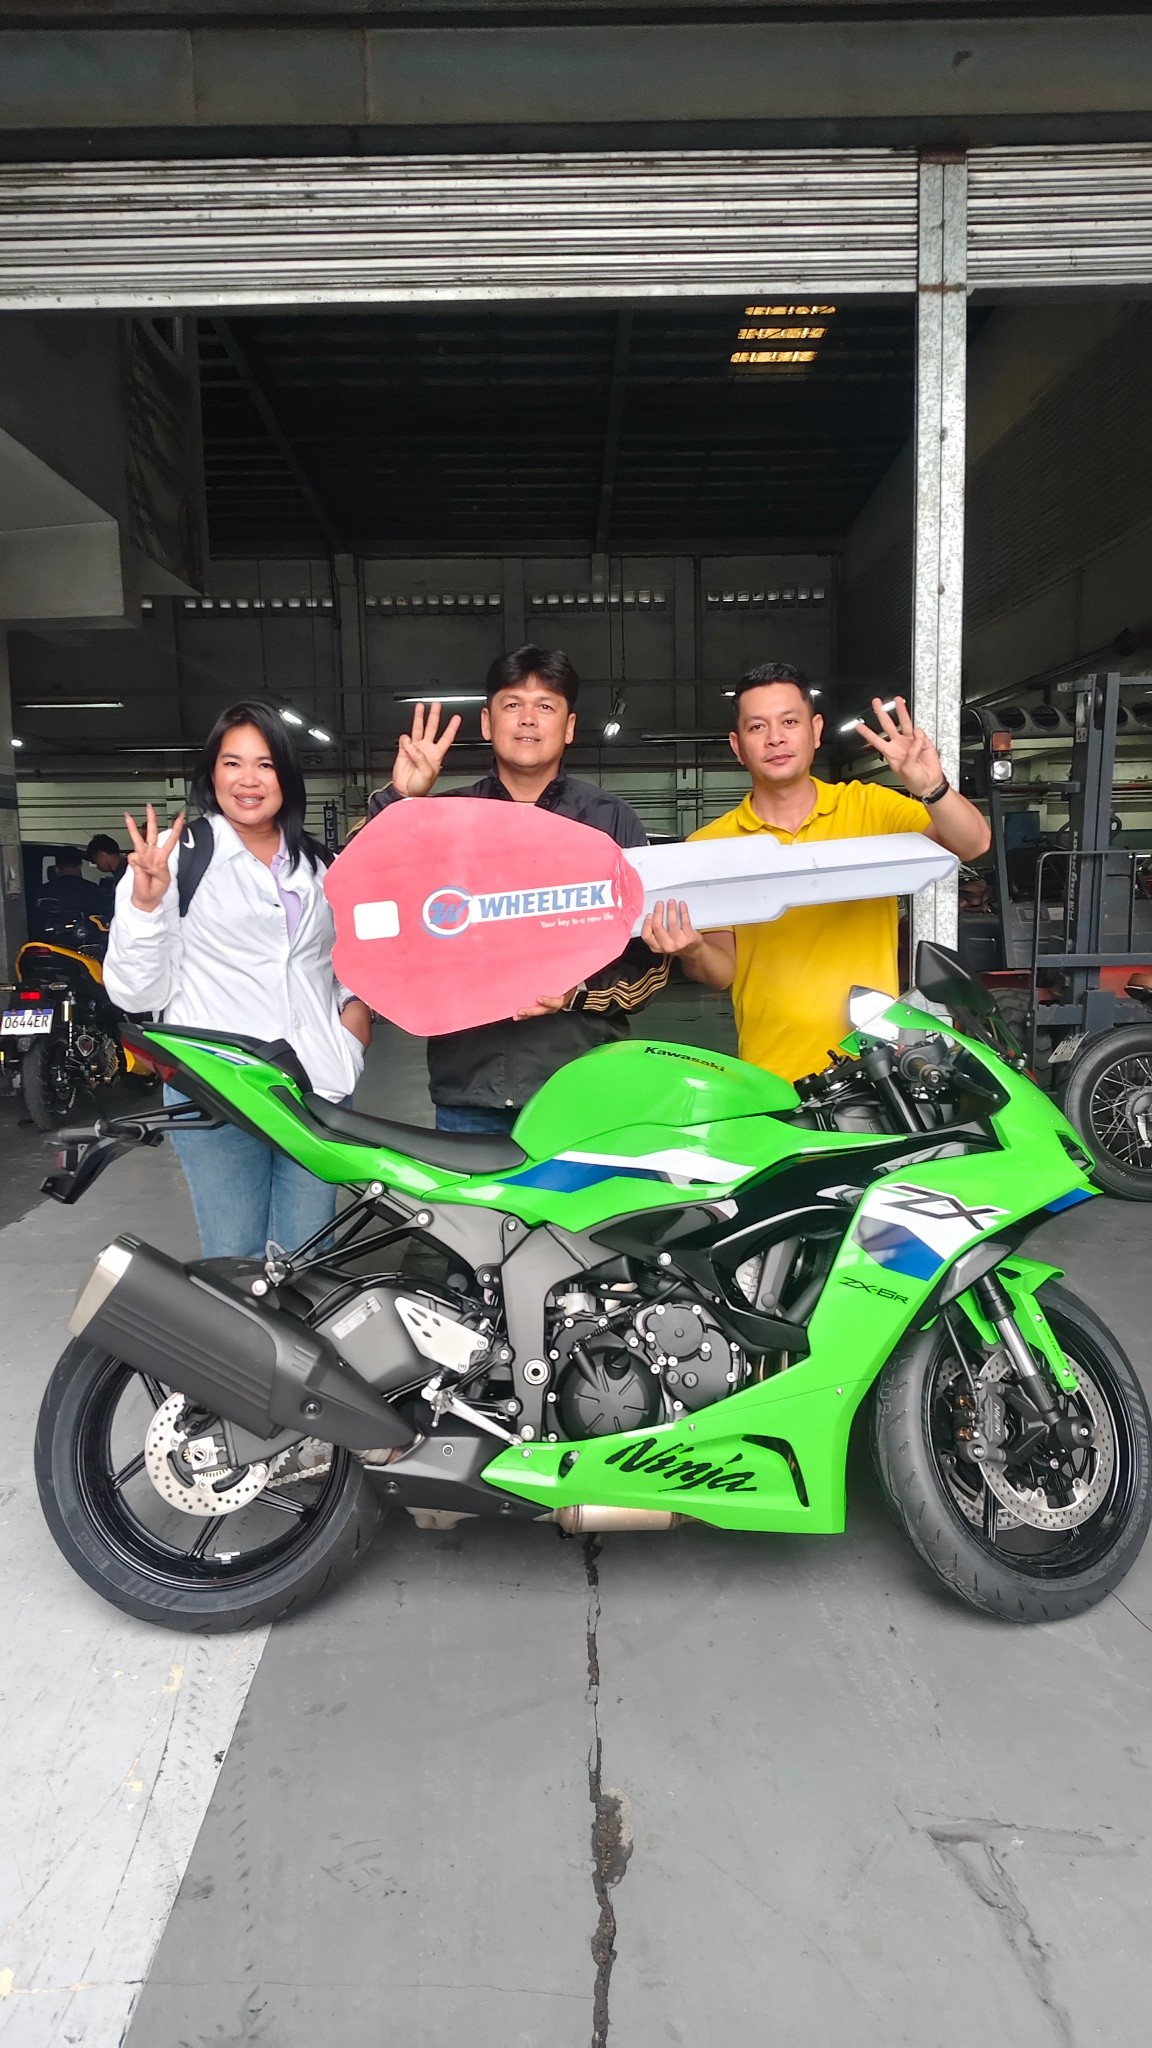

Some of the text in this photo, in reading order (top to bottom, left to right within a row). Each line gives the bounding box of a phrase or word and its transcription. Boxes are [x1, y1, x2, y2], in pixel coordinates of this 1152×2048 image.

[477, 883, 606, 919] WHEELTEK
[539, 919, 556, 929] Your
[557, 917, 570, 928] key
[571, 916, 579, 925] to
[587, 915, 601, 924] new
[602, 912, 615, 922] life
[4, 1015, 49, 1029] 0644ER
[643, 1046, 725, 1072] Kawasaki
[879, 1184, 1001, 1231] ZX
[838, 1276, 909, 1305] ZX-6R
[604, 1437, 758, 1493] Ninja
[1139, 1437, 1149, 1500] DIABLO
